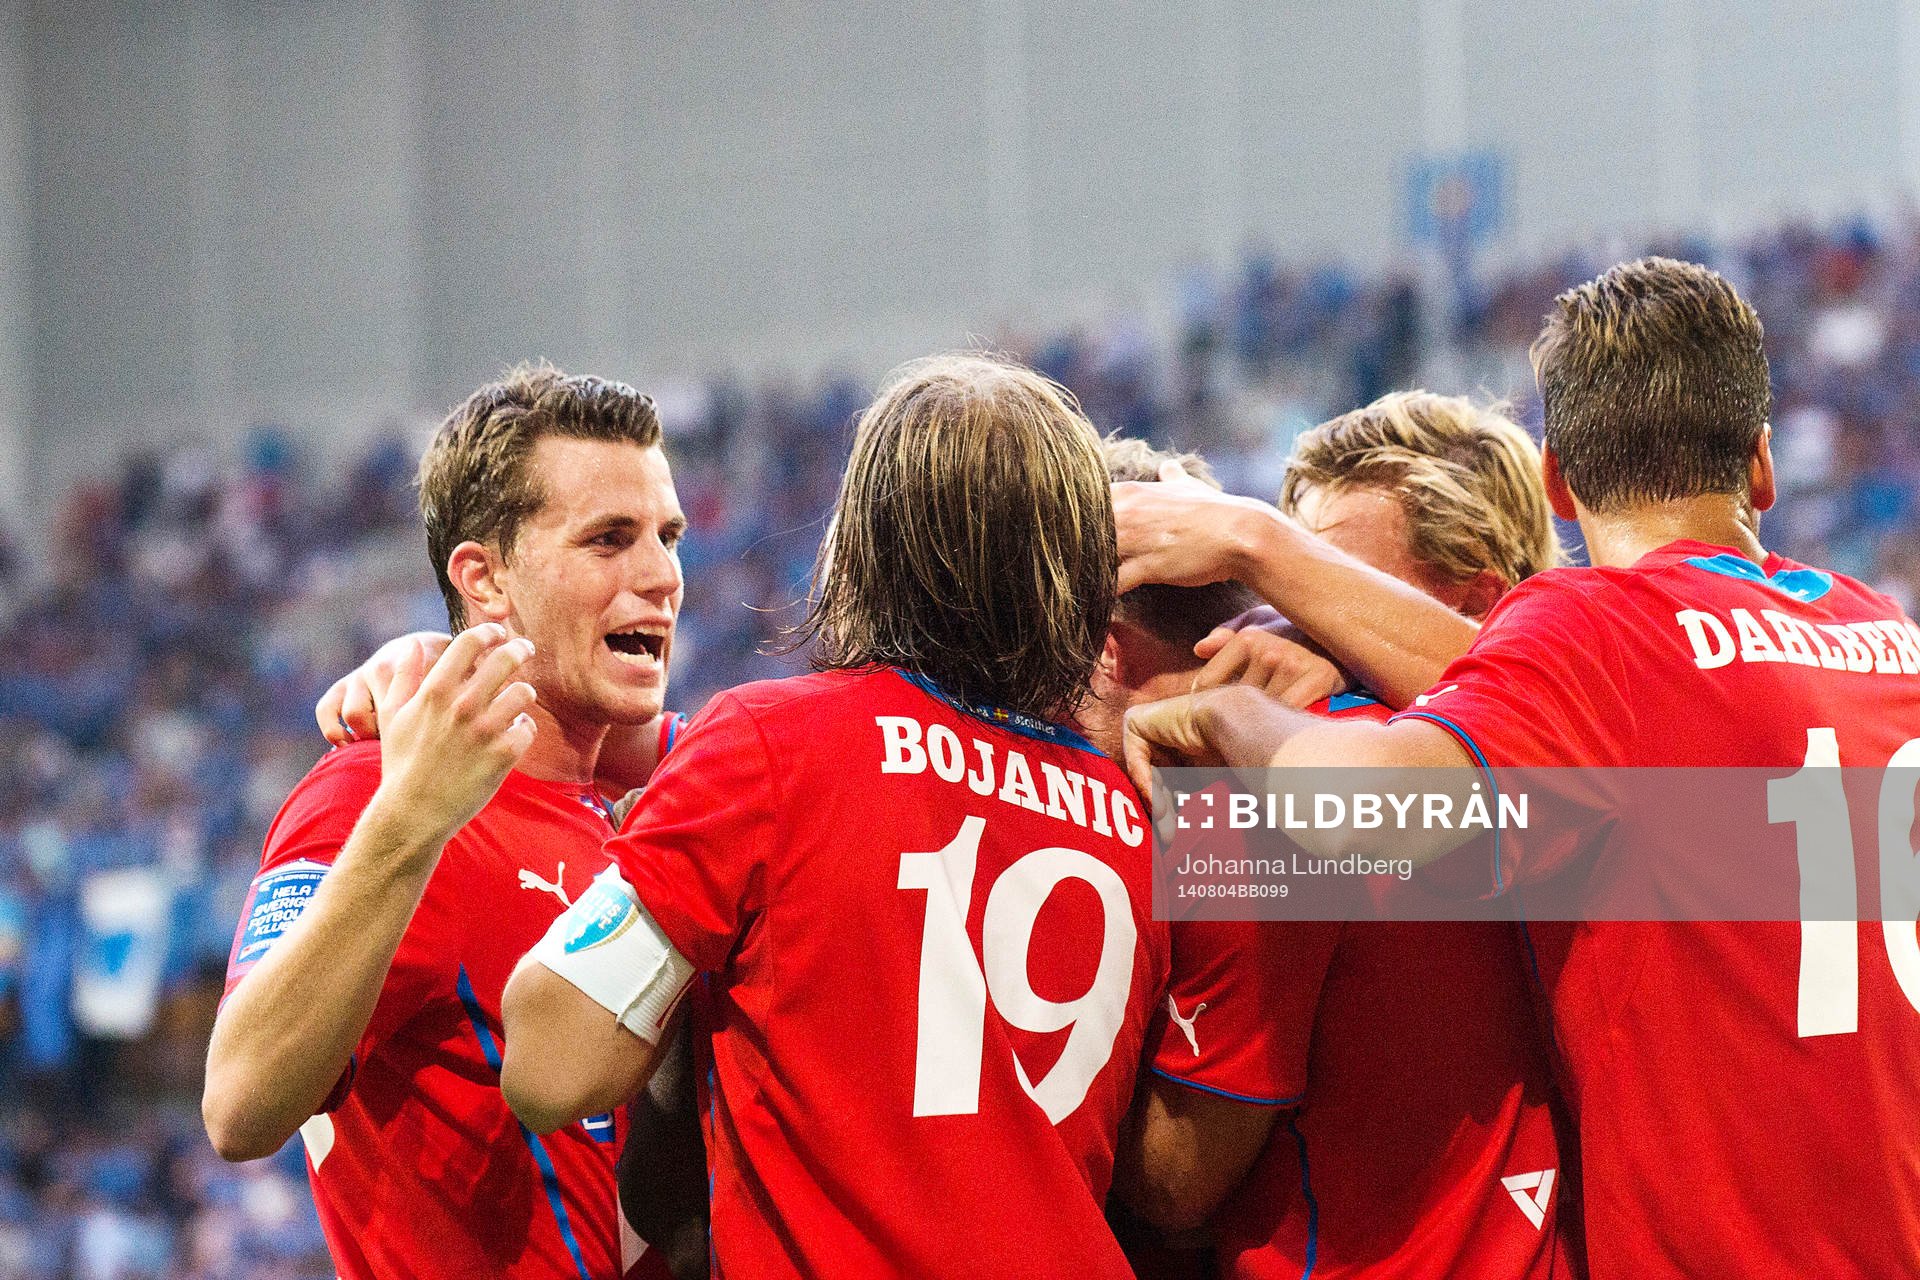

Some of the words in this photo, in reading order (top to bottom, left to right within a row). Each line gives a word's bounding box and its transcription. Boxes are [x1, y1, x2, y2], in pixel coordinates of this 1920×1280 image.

[1676, 608, 1920, 675] DAHLBER
[875, 716, 1145, 848] BOJANIC
[248, 909, 299, 930] FOTBOL
[273, 885, 311, 899] HELA
[897, 815, 1138, 1127] 19
